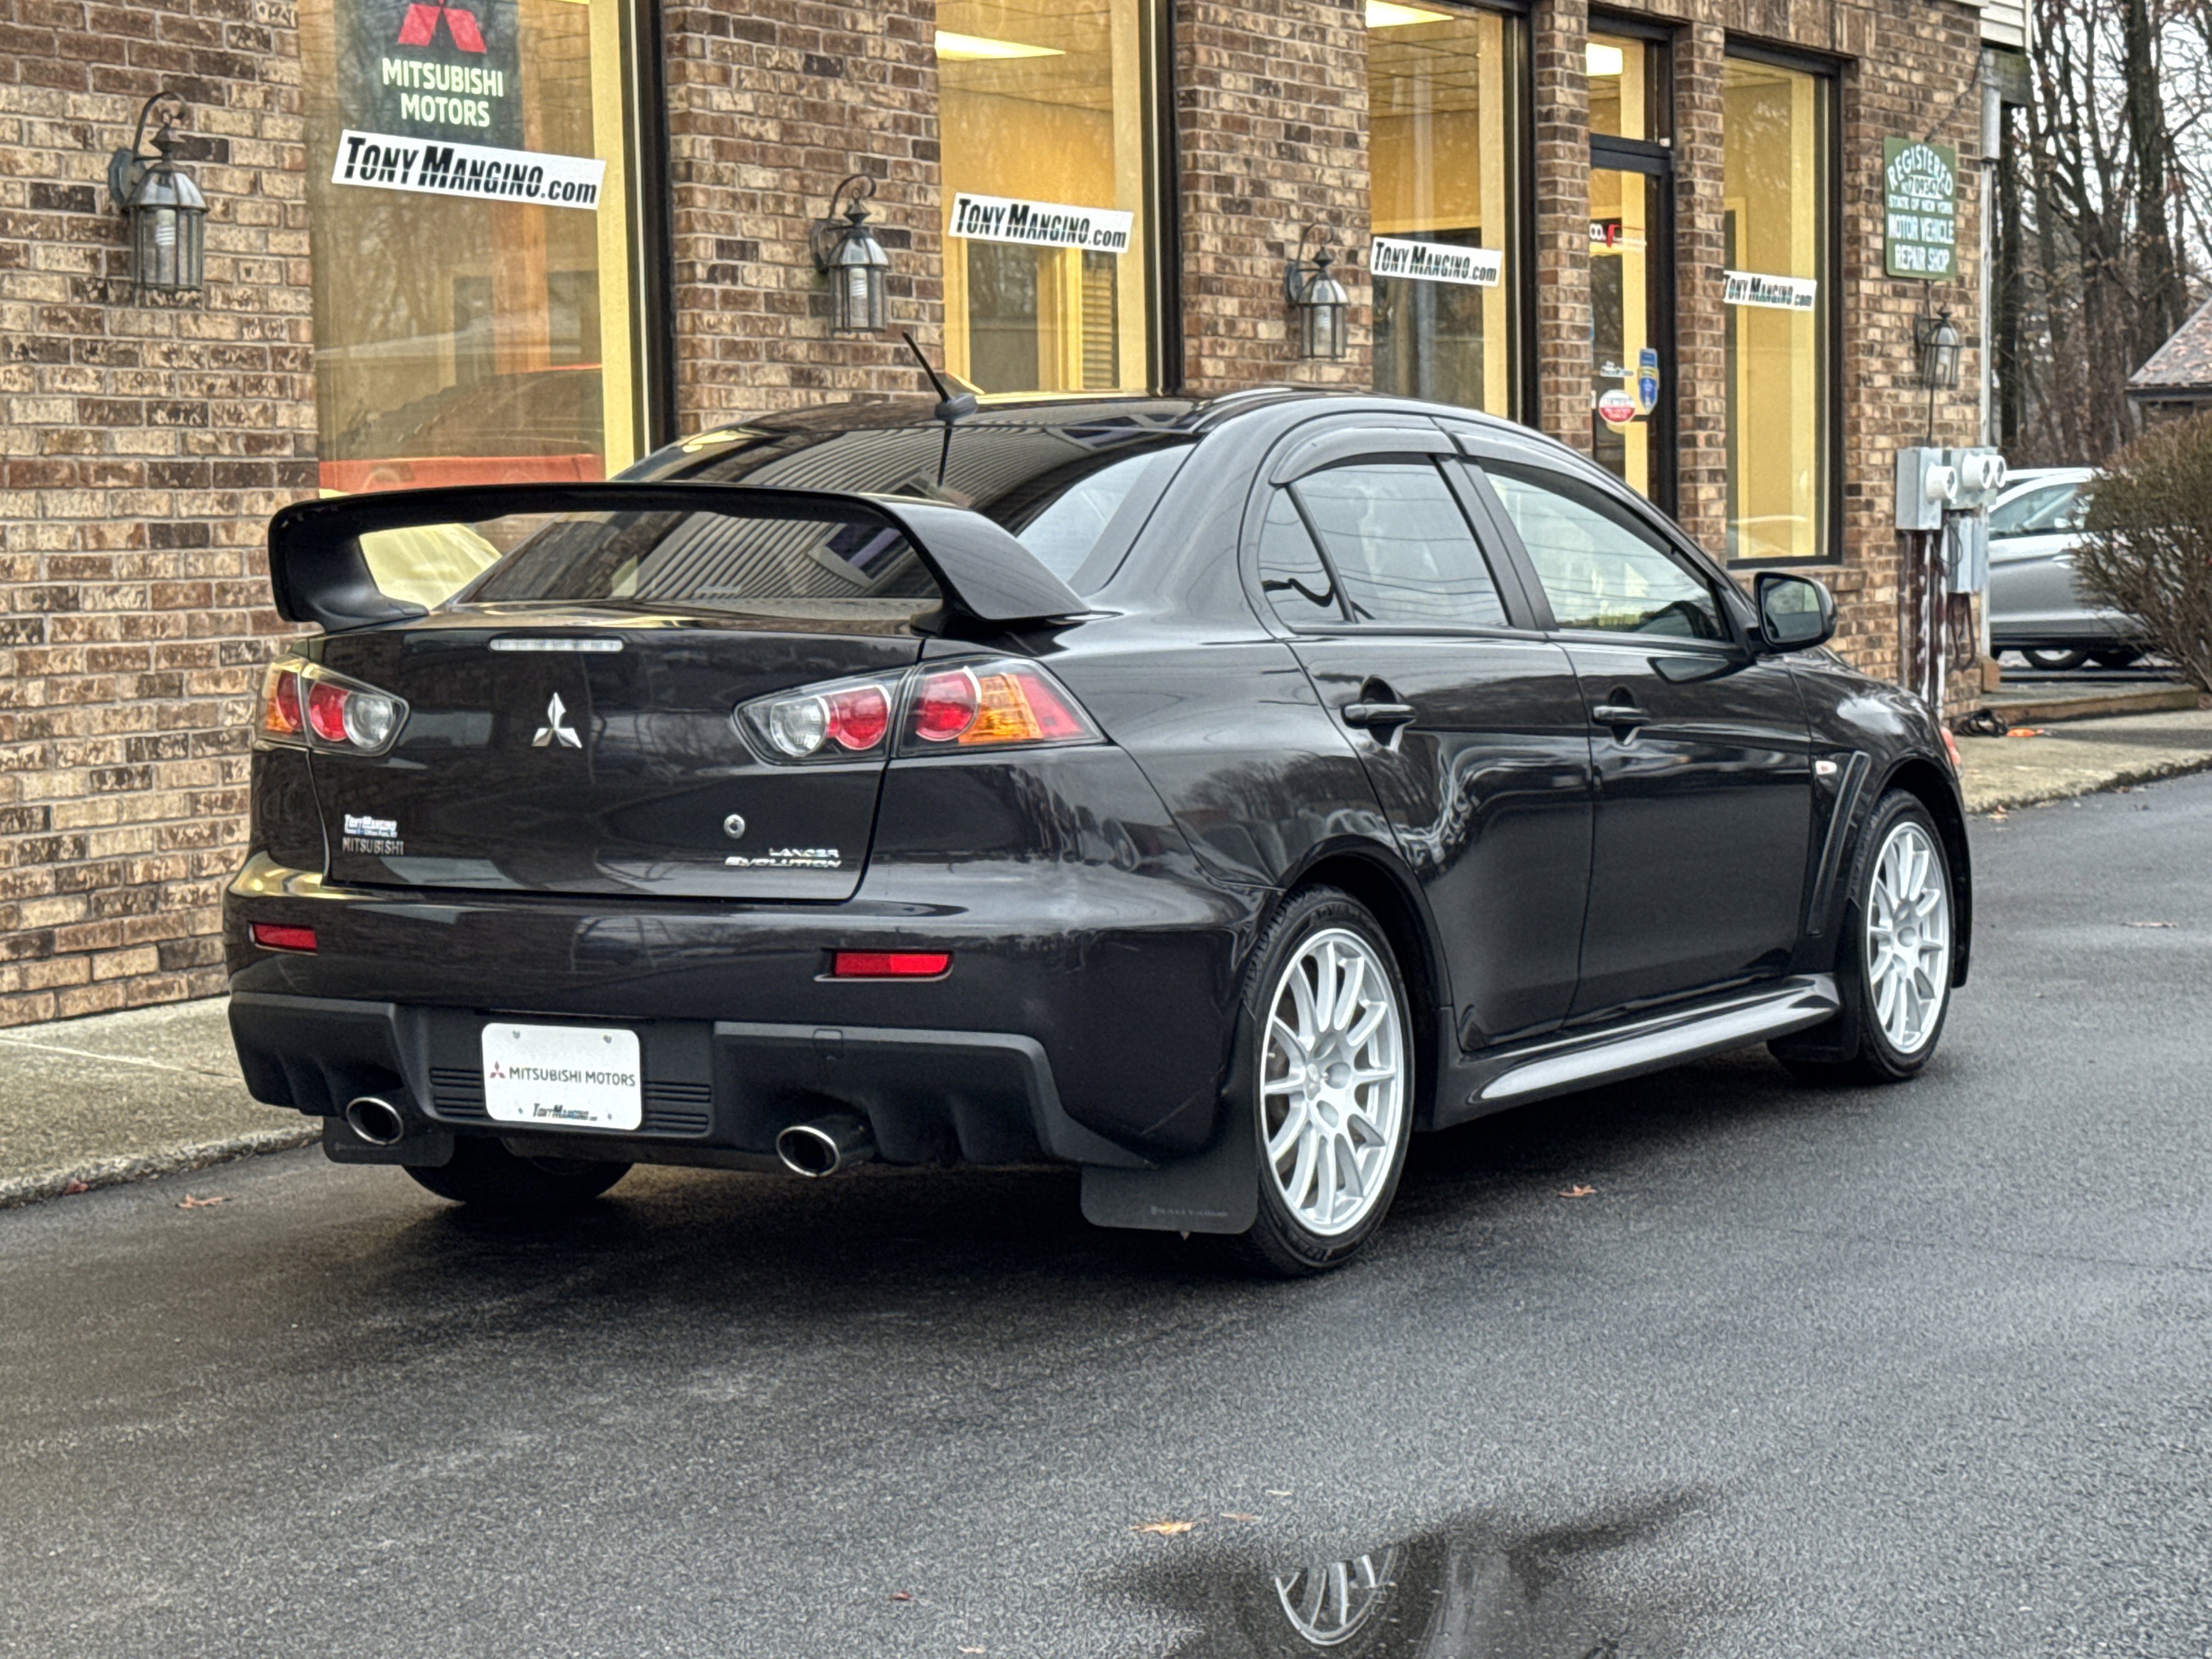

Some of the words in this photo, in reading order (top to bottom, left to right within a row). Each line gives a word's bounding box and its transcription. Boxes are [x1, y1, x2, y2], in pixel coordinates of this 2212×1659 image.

[382, 58, 504, 97] MITSUBISHI
[400, 92, 490, 128] MOTORS
[1887, 144, 1953, 196] REGISTERED
[1888, 213, 1919, 241] MOTOR
[1920, 216, 1955, 245] VEHICLE
[1894, 243, 1926, 271] REPAIR
[1927, 246, 1950, 273] SHOP
[342, 837, 404, 856] MITSUBISHI
[769, 848, 840, 859] LANCER
[509, 1066, 582, 1084] MITSUBISHI
[585, 1070, 636, 1087] MOTORS
